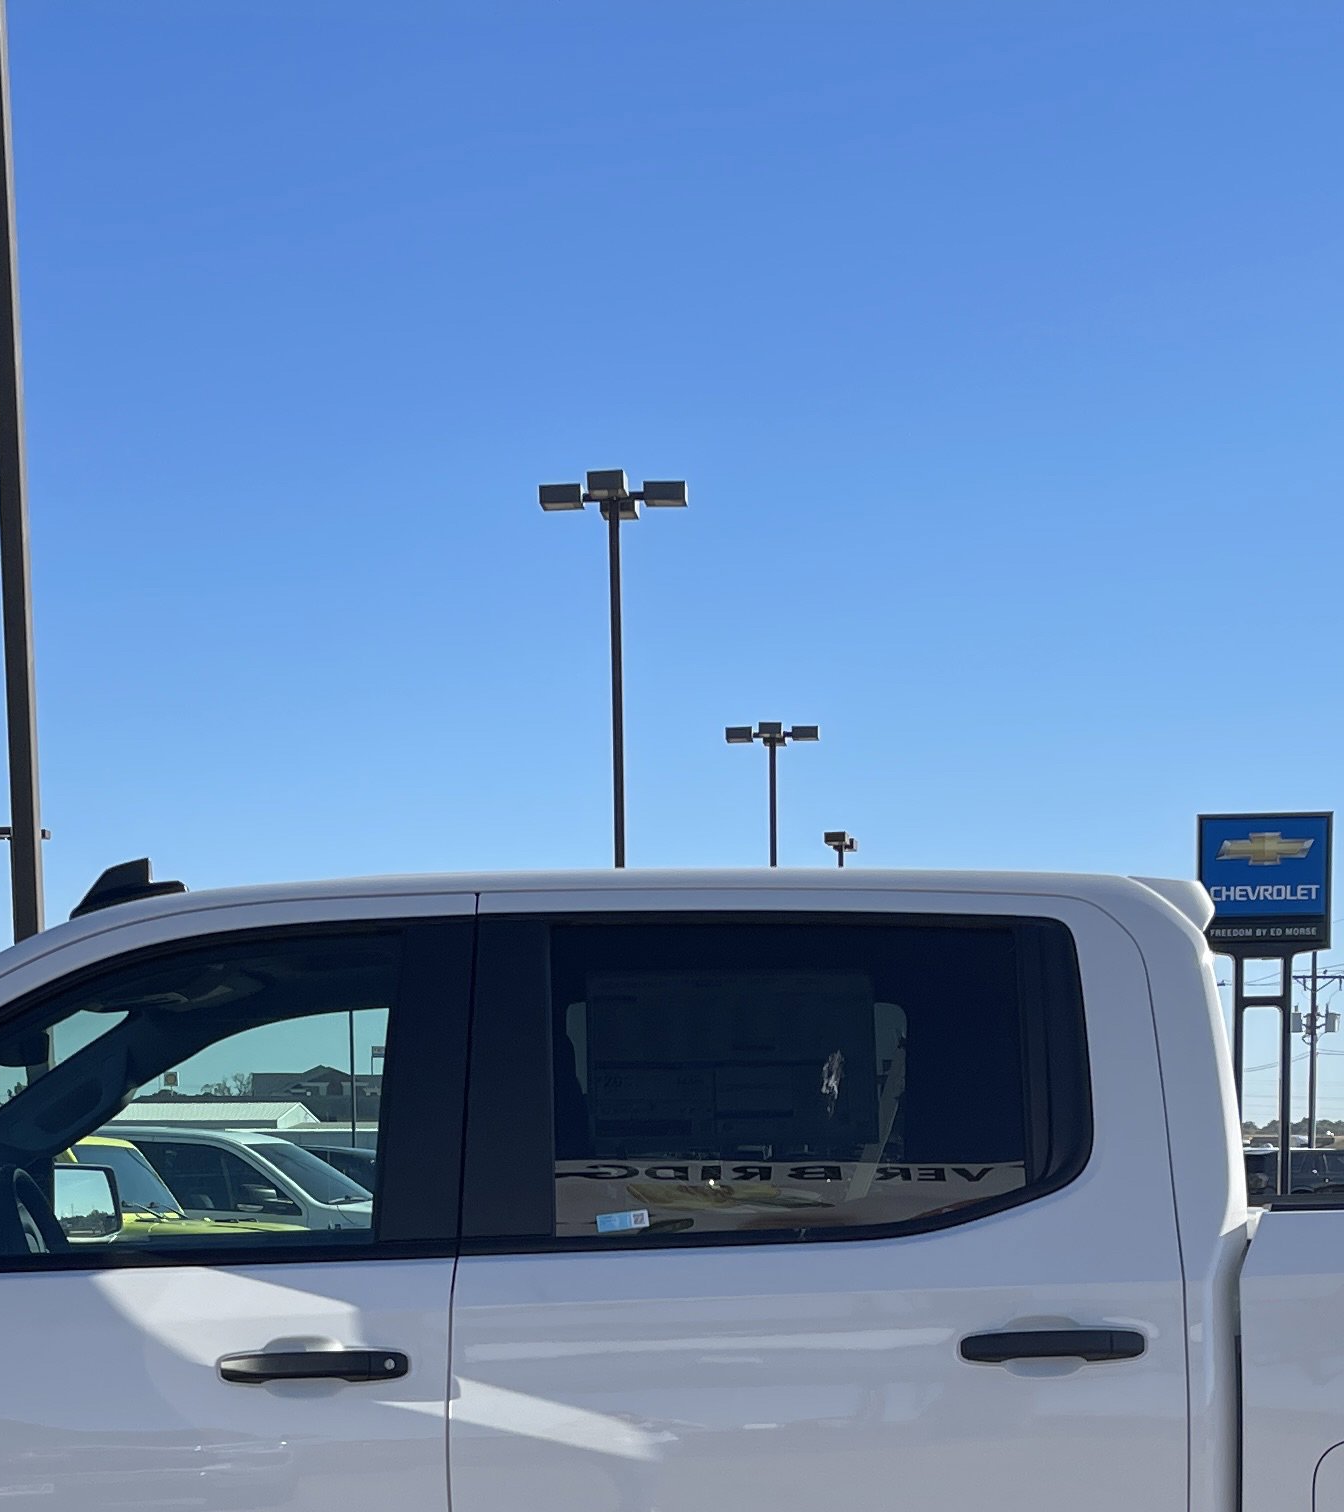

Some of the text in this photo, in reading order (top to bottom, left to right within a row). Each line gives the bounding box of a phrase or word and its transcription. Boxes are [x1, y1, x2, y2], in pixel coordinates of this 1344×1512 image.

[1210, 885, 1320, 902] CHEVROLET
[1210, 926, 1317, 937] FREEDOM BY ED MORSE
